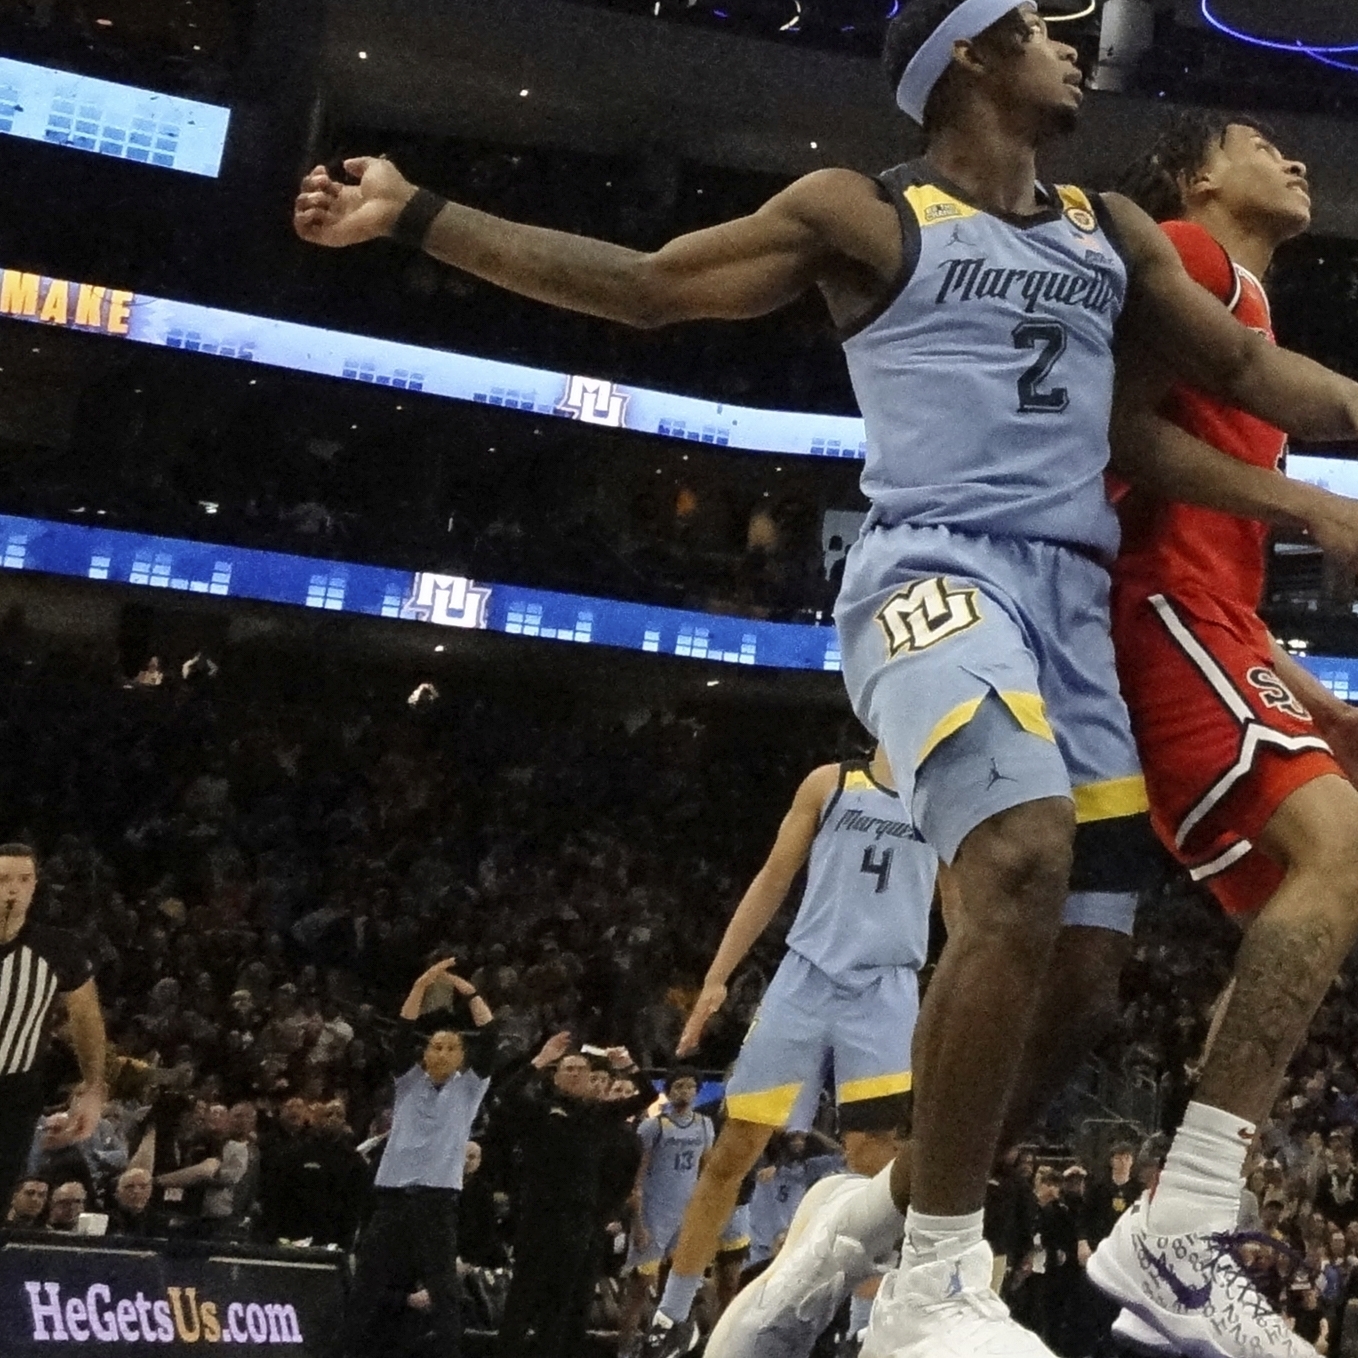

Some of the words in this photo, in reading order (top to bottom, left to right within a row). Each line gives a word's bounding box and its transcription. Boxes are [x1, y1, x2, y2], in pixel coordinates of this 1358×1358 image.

[0, 269, 134, 334] MAKE
[1011, 320, 1070, 414] 2
[875, 576, 982, 660] MU
[860, 844, 895, 894] 4
[24, 1280, 303, 1344] HeGetsUs.com
